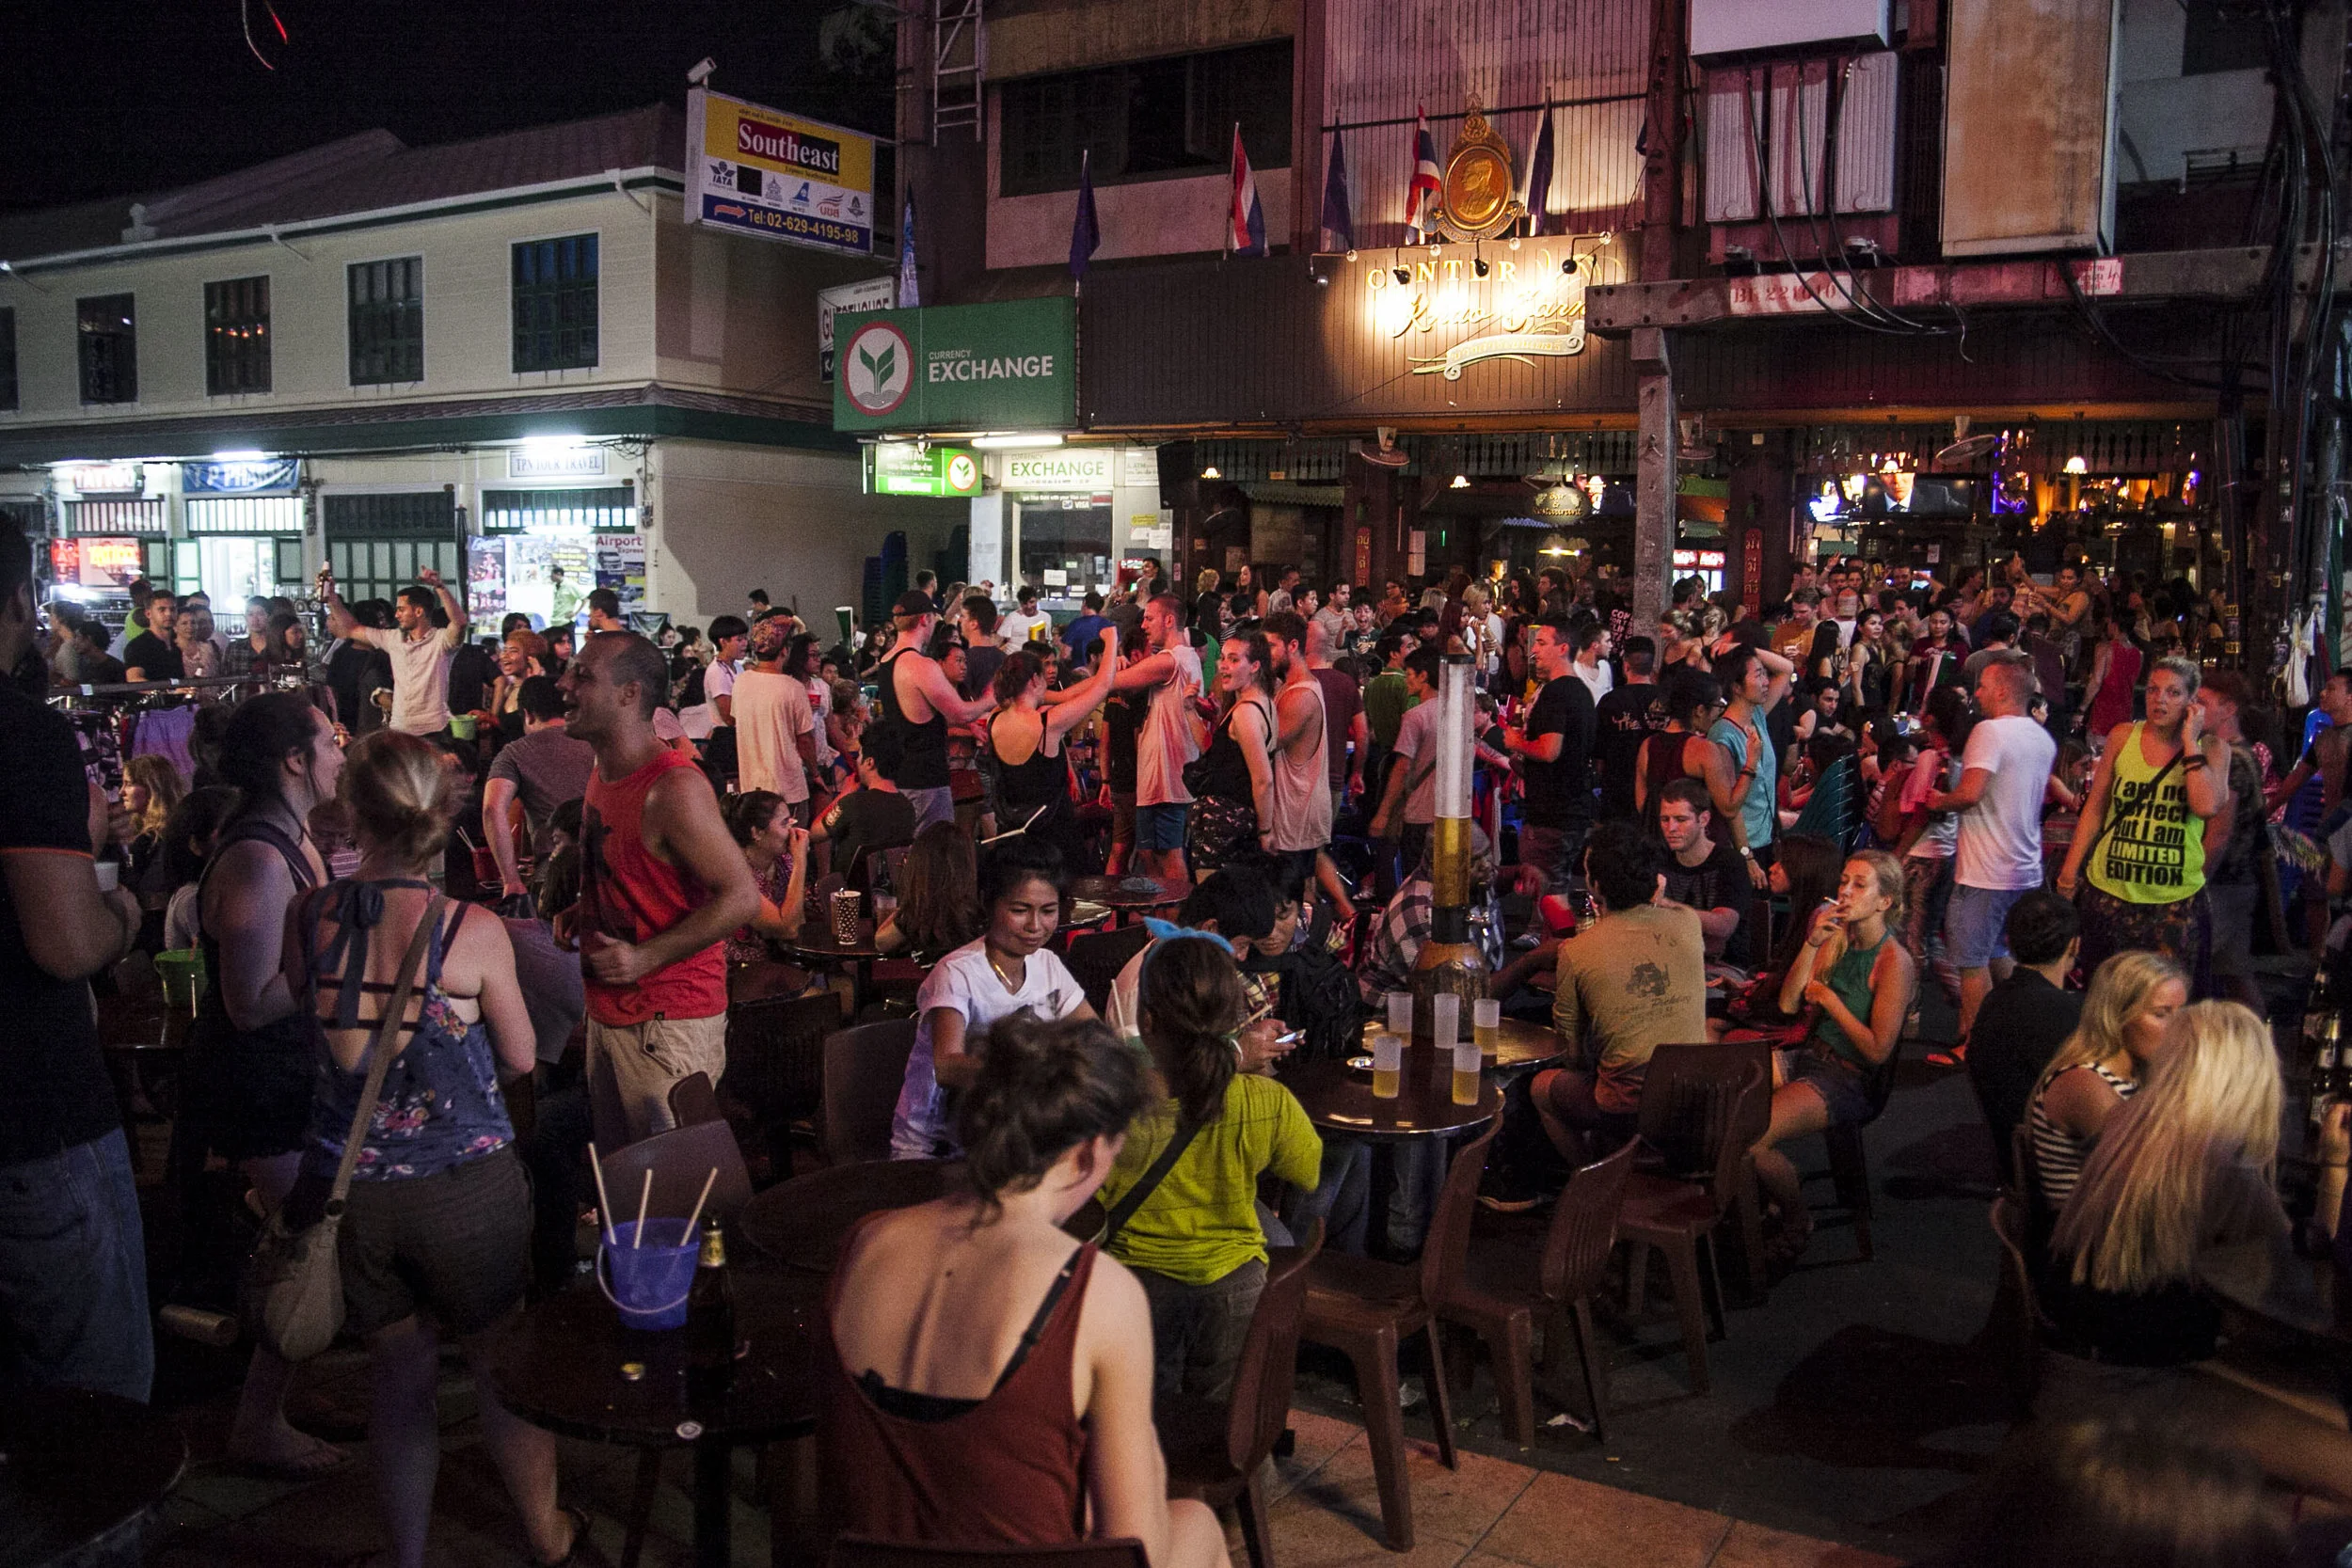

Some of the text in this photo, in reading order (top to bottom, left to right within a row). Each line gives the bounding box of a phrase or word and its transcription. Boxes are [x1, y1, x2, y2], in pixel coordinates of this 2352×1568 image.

[739, 123, 839, 171] Southeast
[712, 174, 733, 186] IATA
[929, 349, 972, 361] CURRENCY
[929, 355, 1054, 383] EXCHANGE
[565, 455, 600, 470] TRAVEL
[1010, 461, 1104, 477] EXCHANGE
[1074, 500, 1090, 509] VISA
[596, 535, 644, 548] Airport
[2162, 784, 2188, 802] no
[2141, 819, 2151, 841] I
[2153, 825, 2185, 844] am
[2110, 840, 2181, 864] LIMITED
[2106, 860, 2184, 886] EDITION
